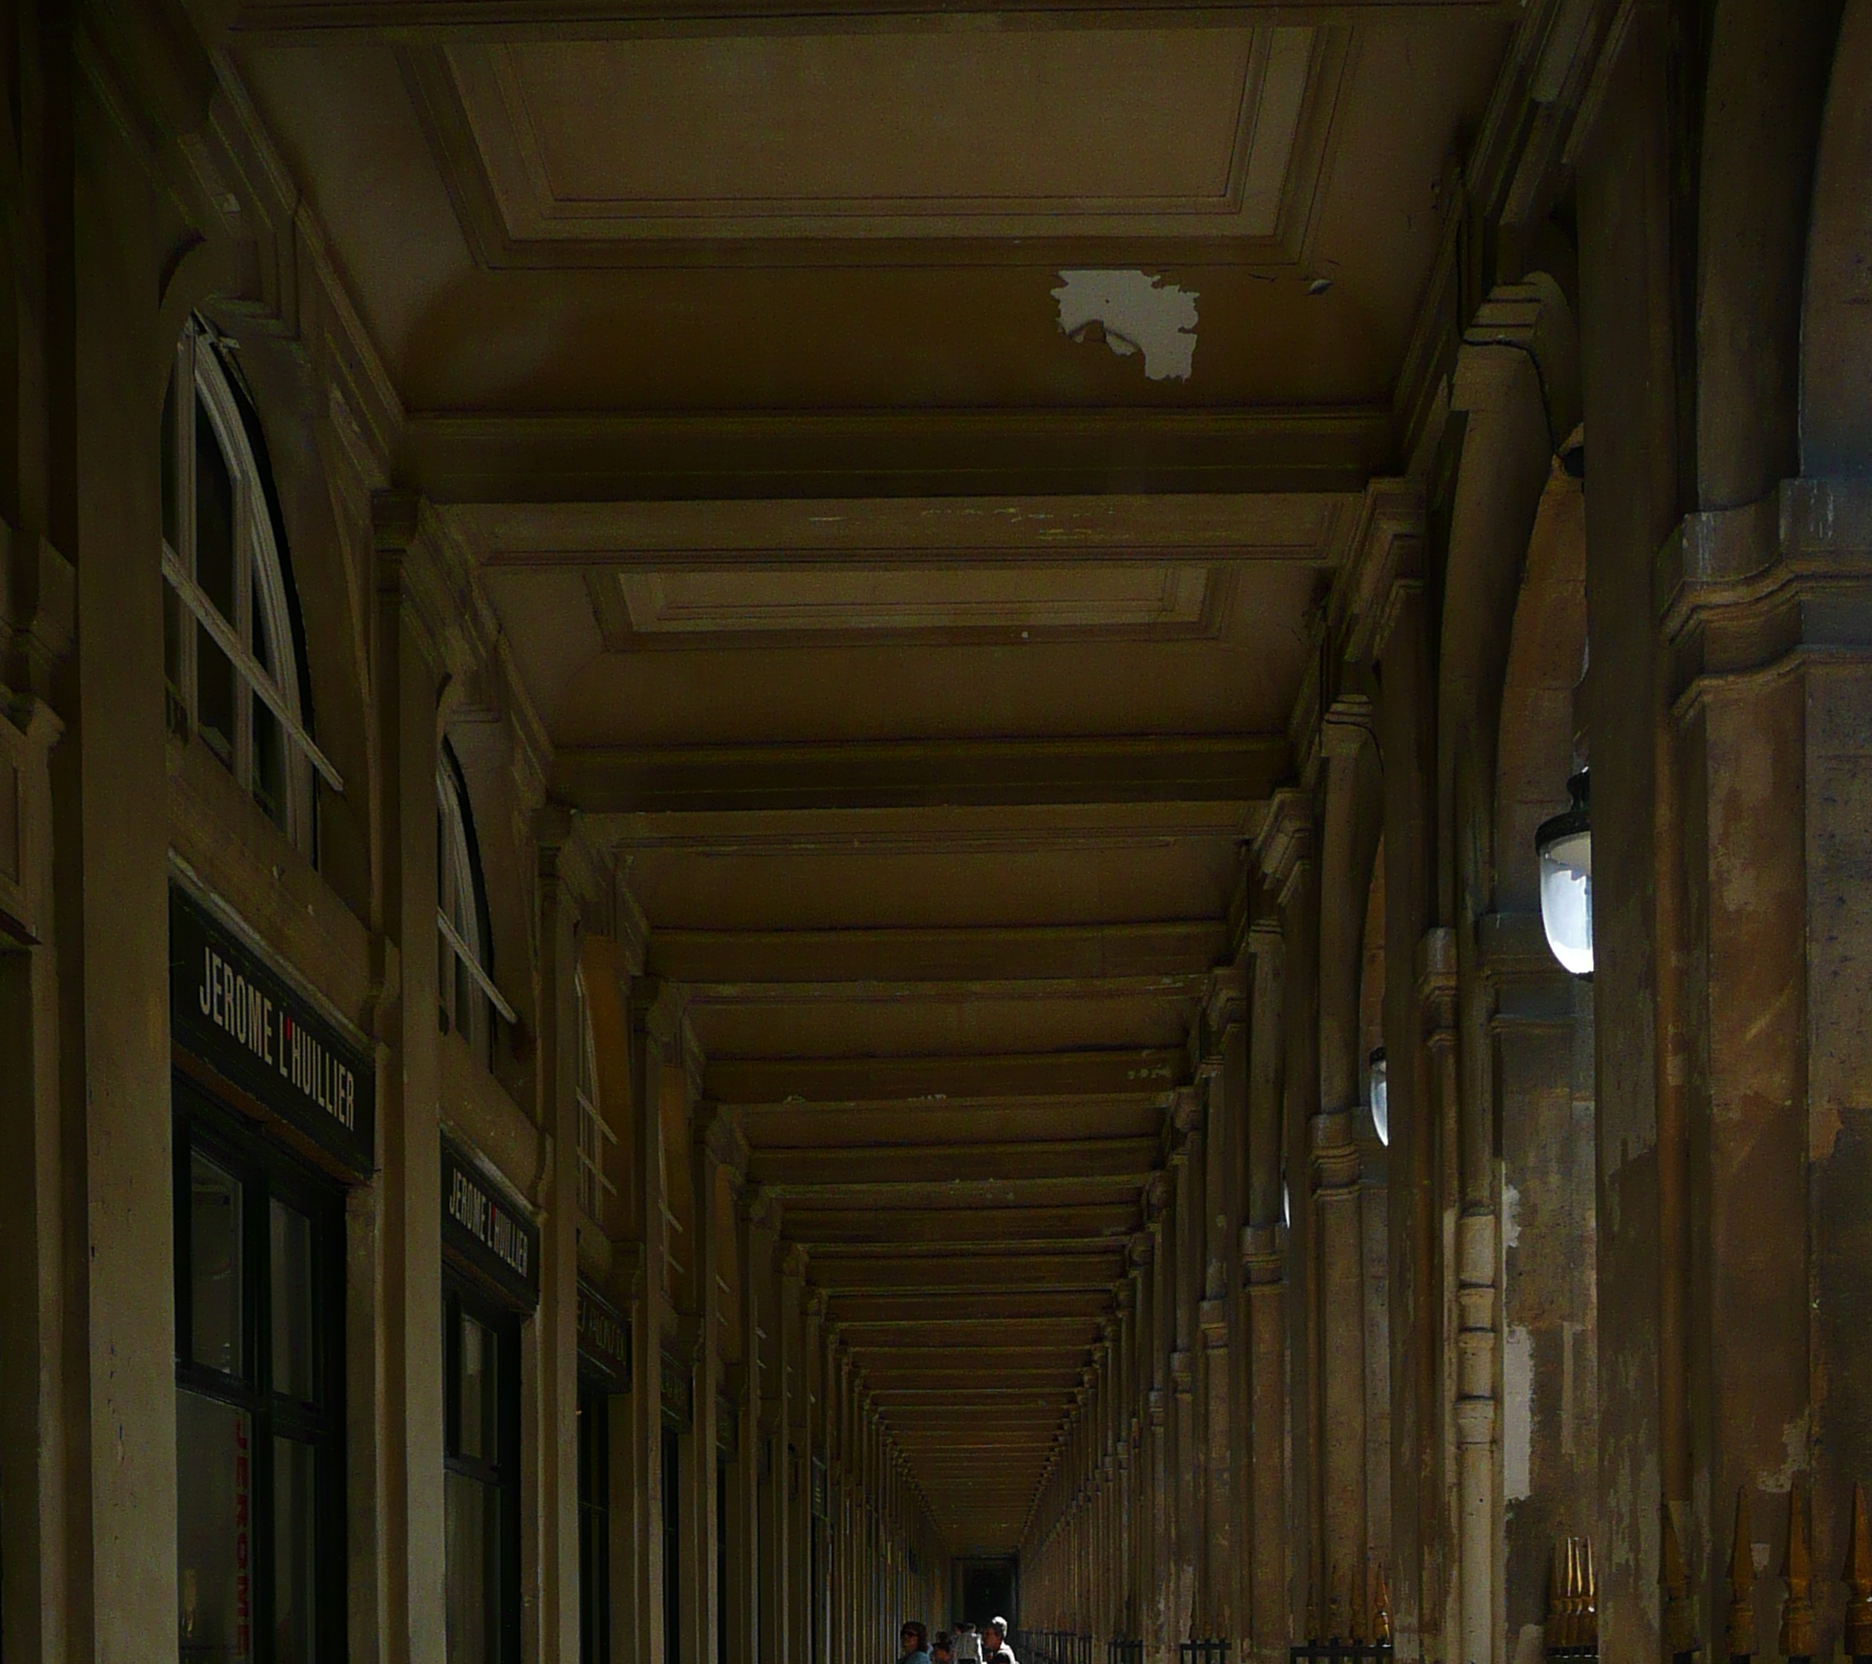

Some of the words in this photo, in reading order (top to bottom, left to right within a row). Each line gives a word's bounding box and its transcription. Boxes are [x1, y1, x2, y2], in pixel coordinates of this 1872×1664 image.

[199, 946, 273, 1066] JEROME
[279, 1011, 355, 1131] L'HUILLIER
[449, 1167, 486, 1242] JEROME
[487, 1201, 528, 1278] L'HUILLIER
